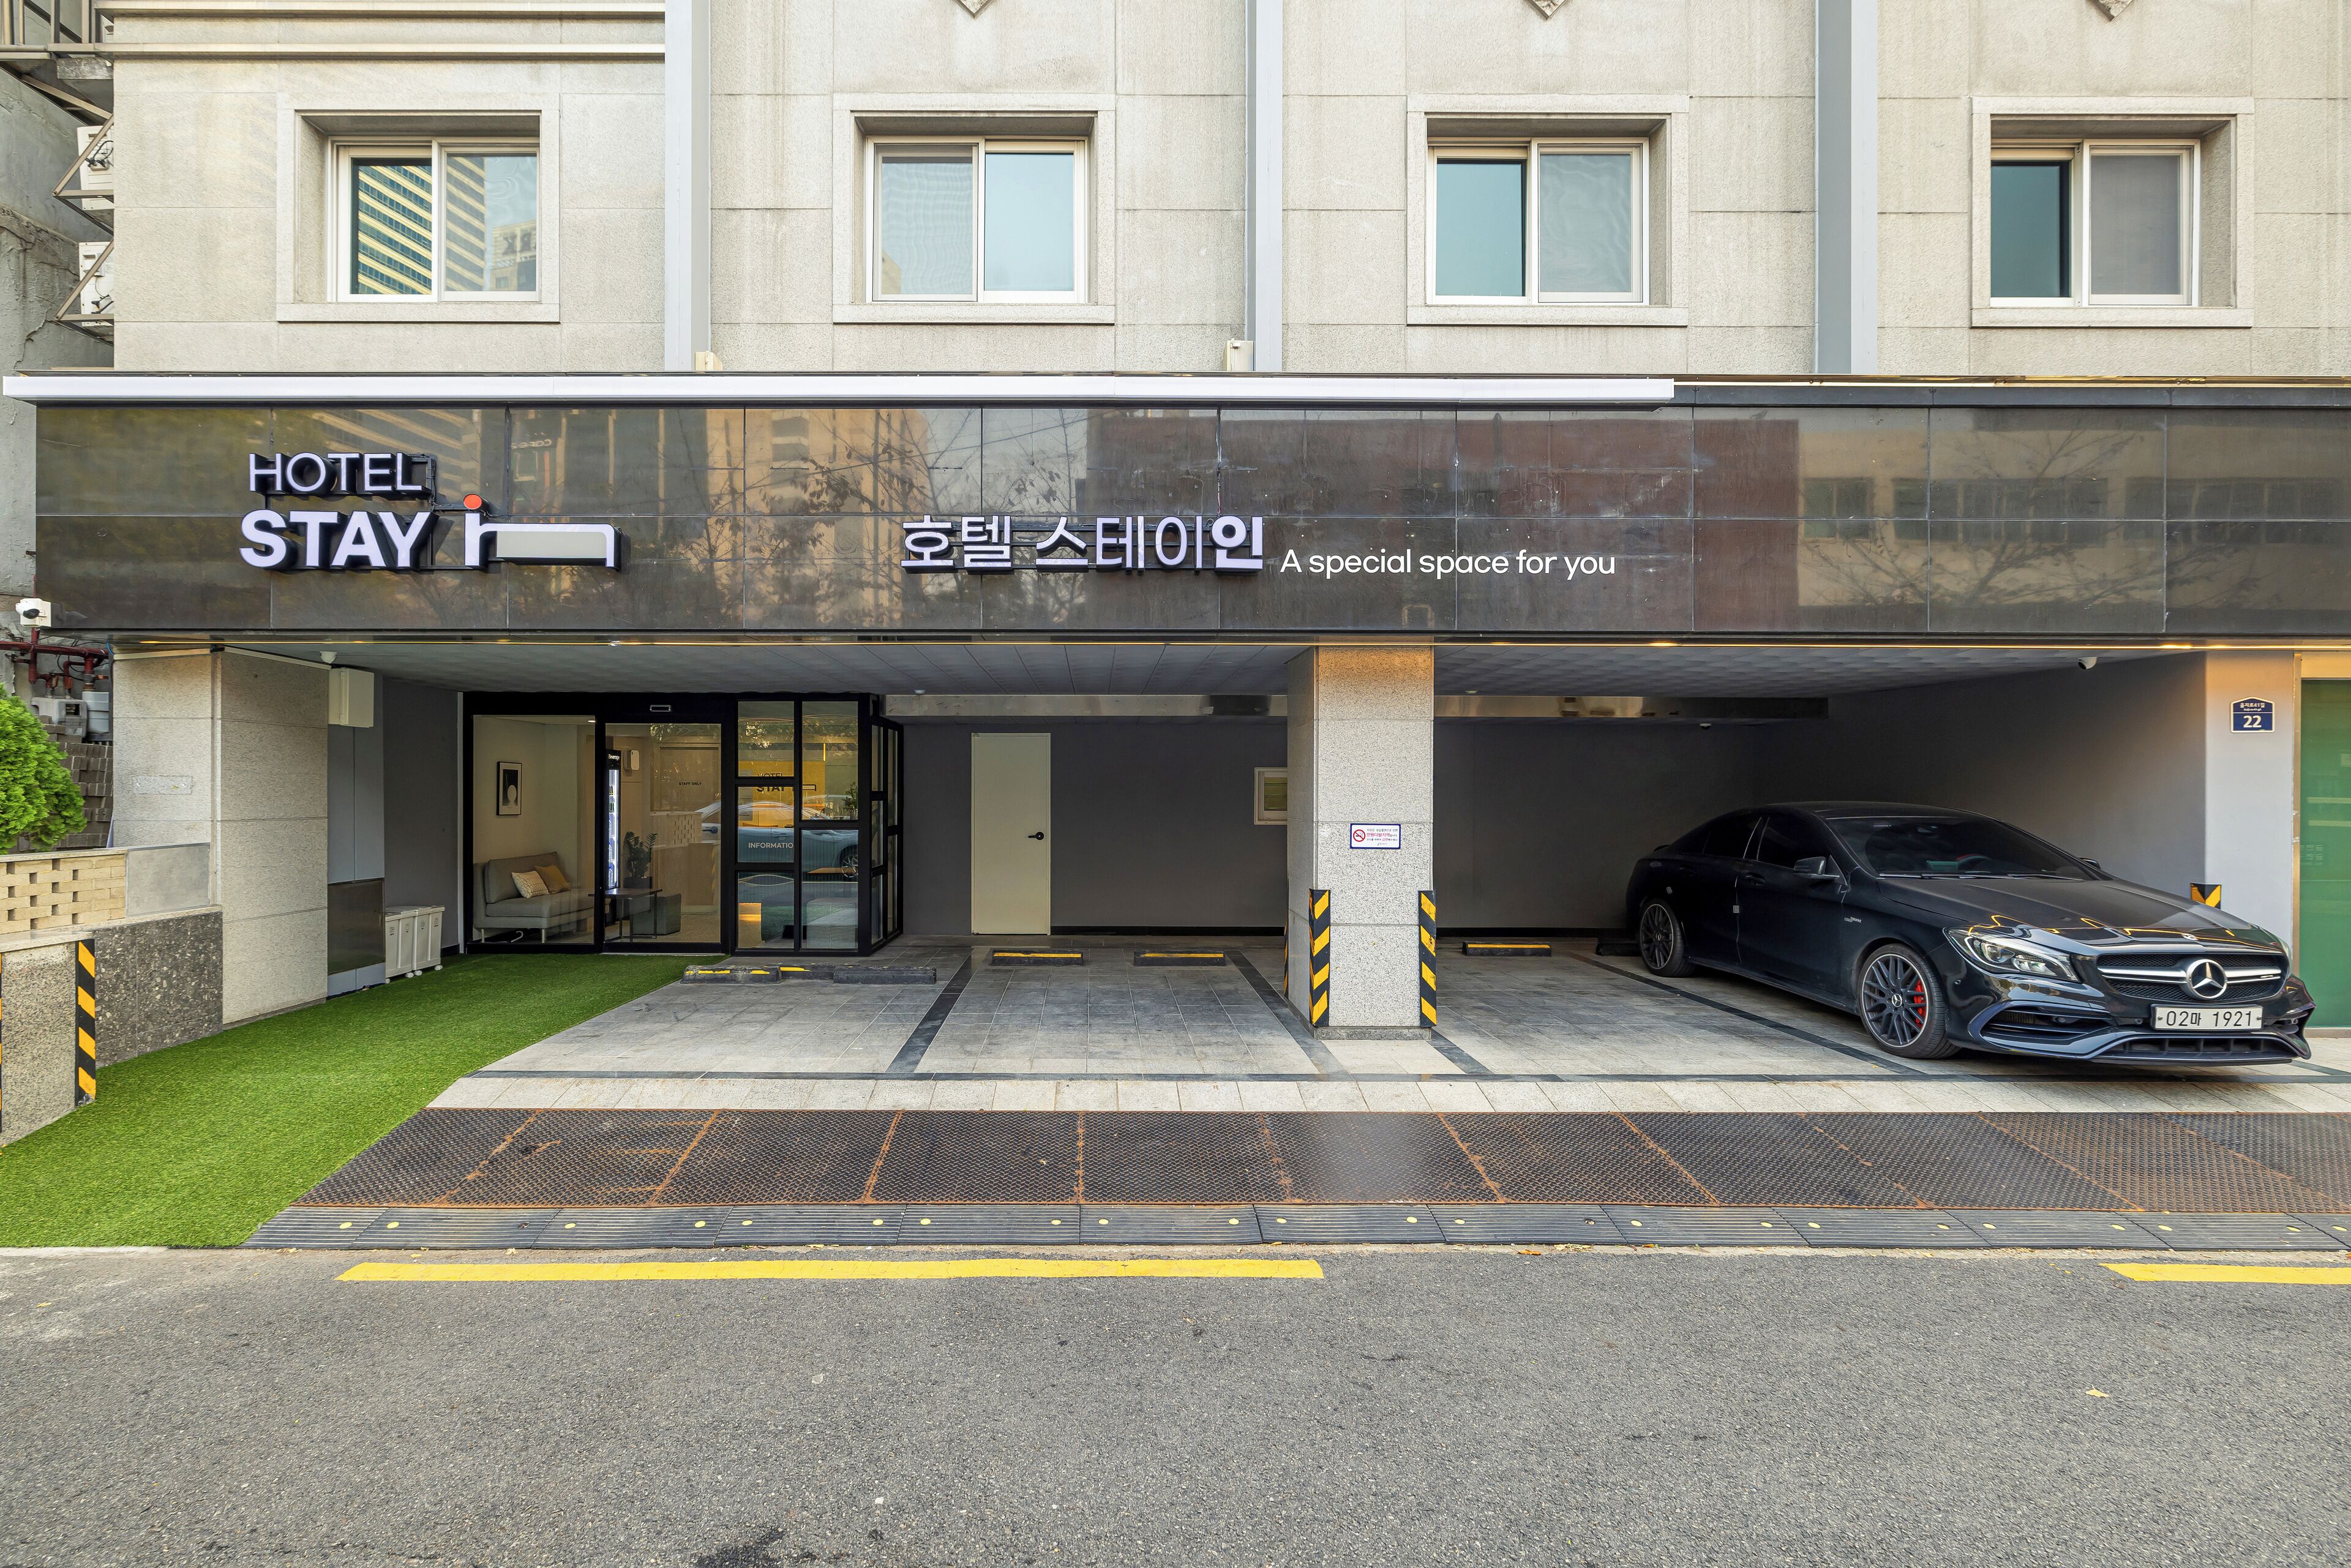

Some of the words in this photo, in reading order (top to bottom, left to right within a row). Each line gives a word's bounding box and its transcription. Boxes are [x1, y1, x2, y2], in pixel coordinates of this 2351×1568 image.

[249, 452, 422, 492] HOTEL
[239, 509, 431, 568] STAY
[901, 515, 1013, 568] 호텔
[1035, 516, 1263, 570] 스테이인
[1280, 549, 1303, 573] A
[1309, 549, 1412, 580] special
[1419, 555, 1510, 580] space
[1516, 549, 1558, 574] for
[1563, 555, 1616, 580] you
[2243, 715, 2262, 728] 22
[2166, 1010, 2202, 1027] 02마
[2213, 1010, 2252, 1027] 1921
